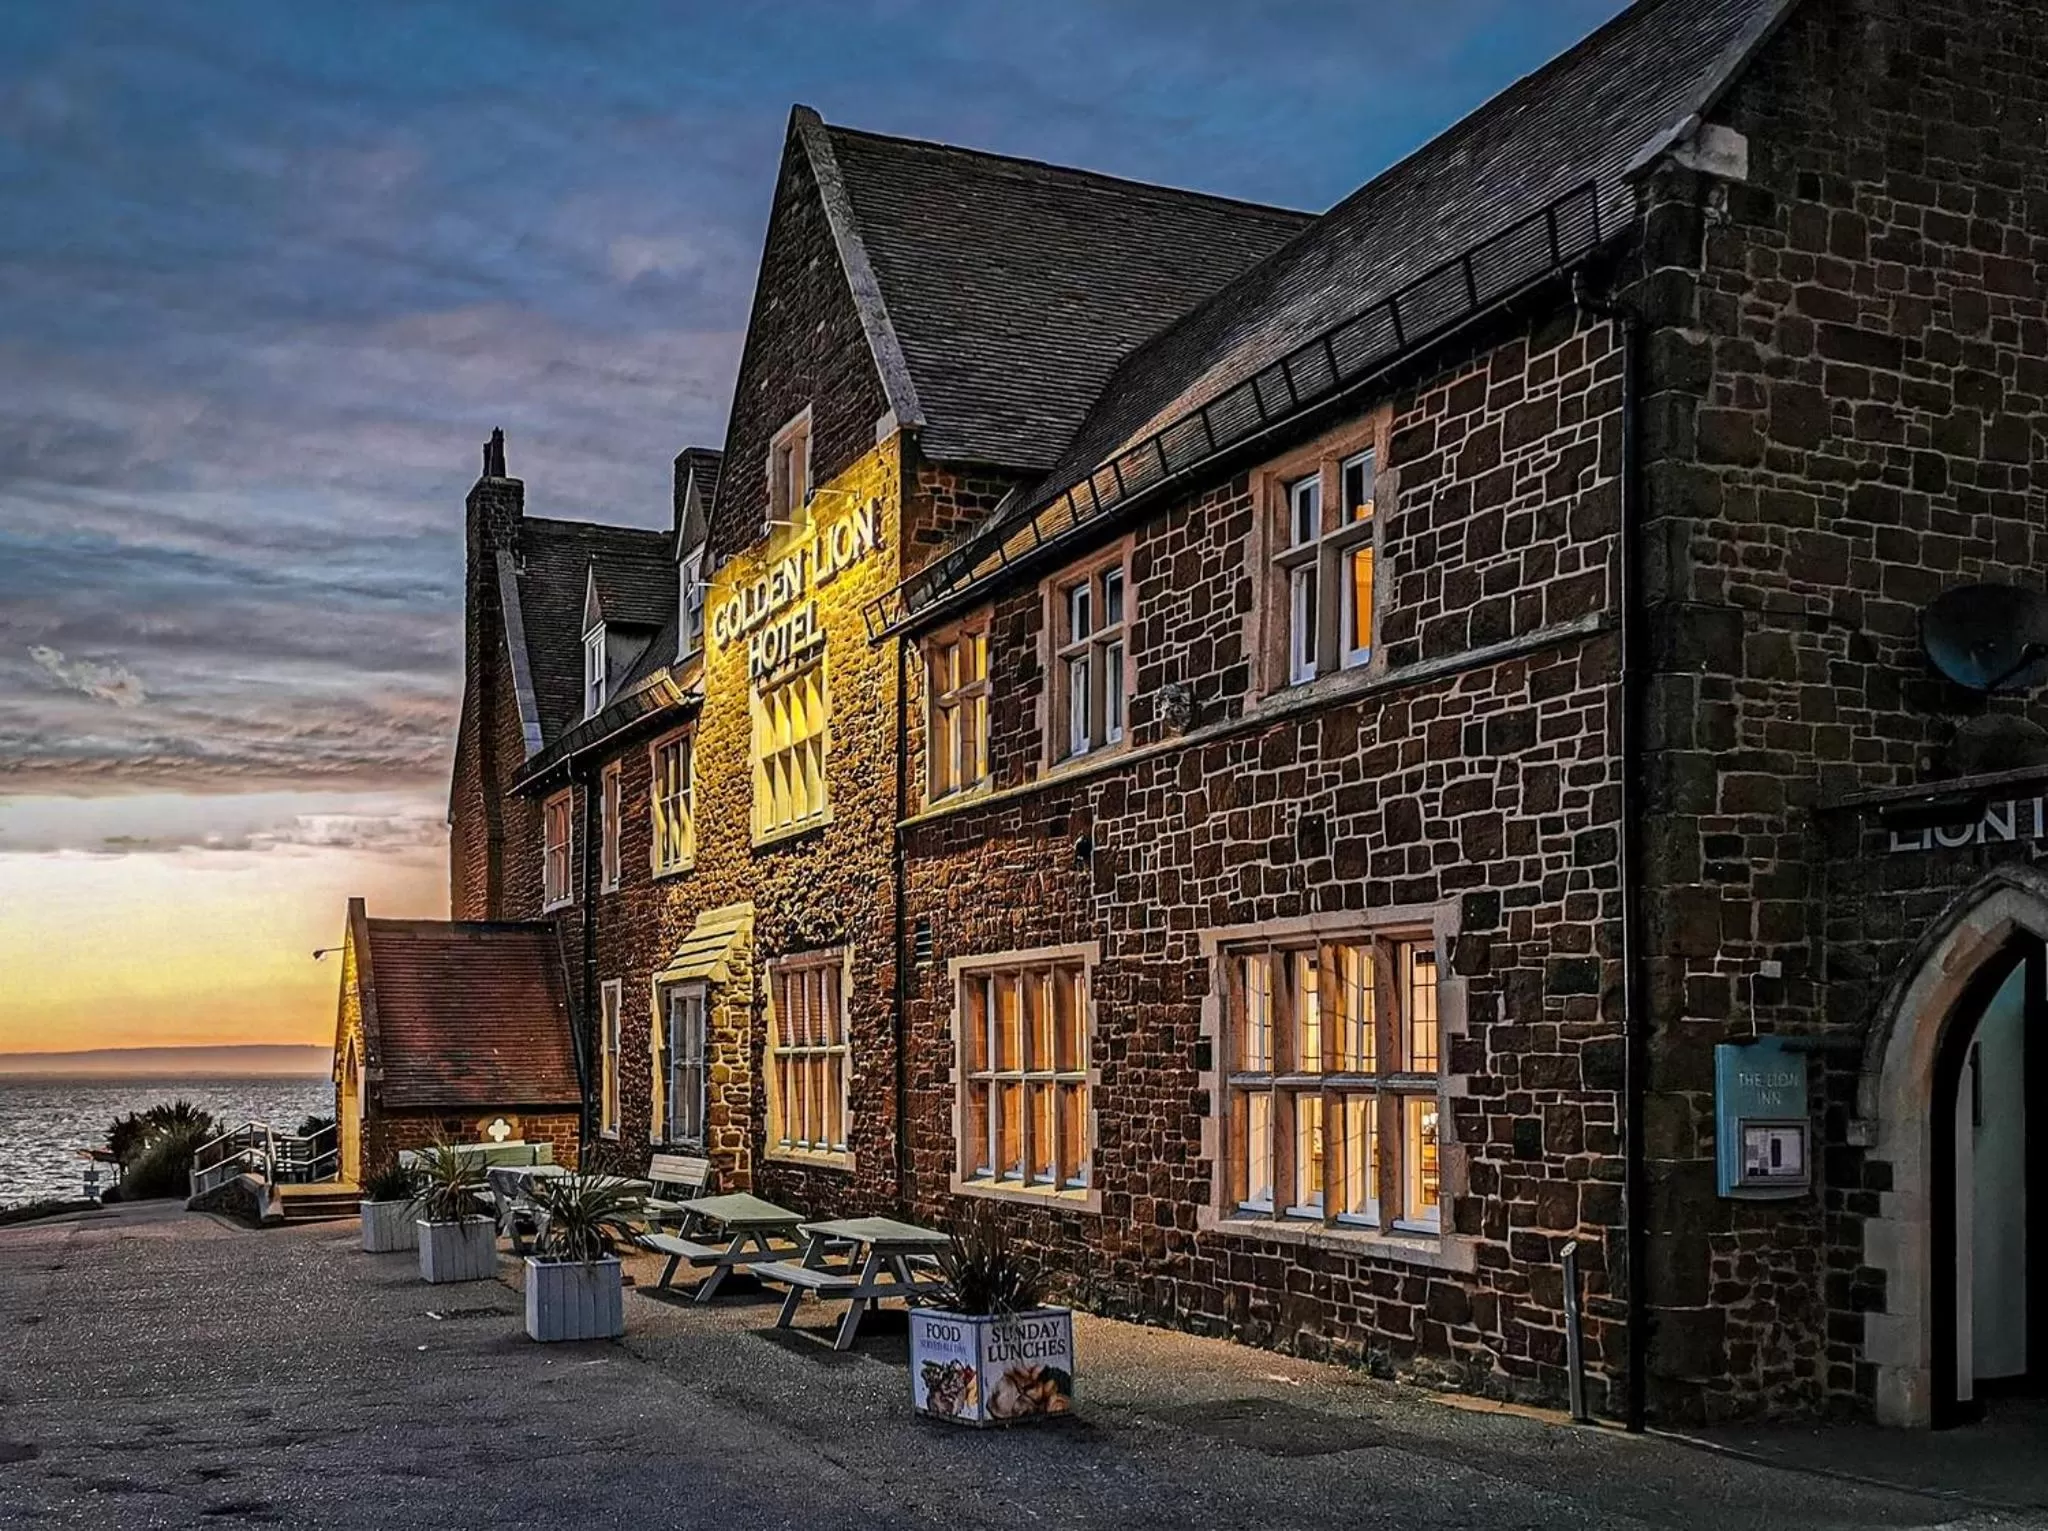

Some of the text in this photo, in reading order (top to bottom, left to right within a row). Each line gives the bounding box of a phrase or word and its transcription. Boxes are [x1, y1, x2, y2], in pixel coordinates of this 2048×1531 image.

[712, 497, 878, 647] GOLDEN LION
[748, 600, 825, 678] HOTEL
[1739, 1072, 1762, 1088] THE
[1758, 1089, 1782, 1105] INN
[926, 1321, 961, 1342] FOOD
[991, 1321, 1061, 1344] SUNDAY
[988, 1338, 1066, 1362] LUNCHES
